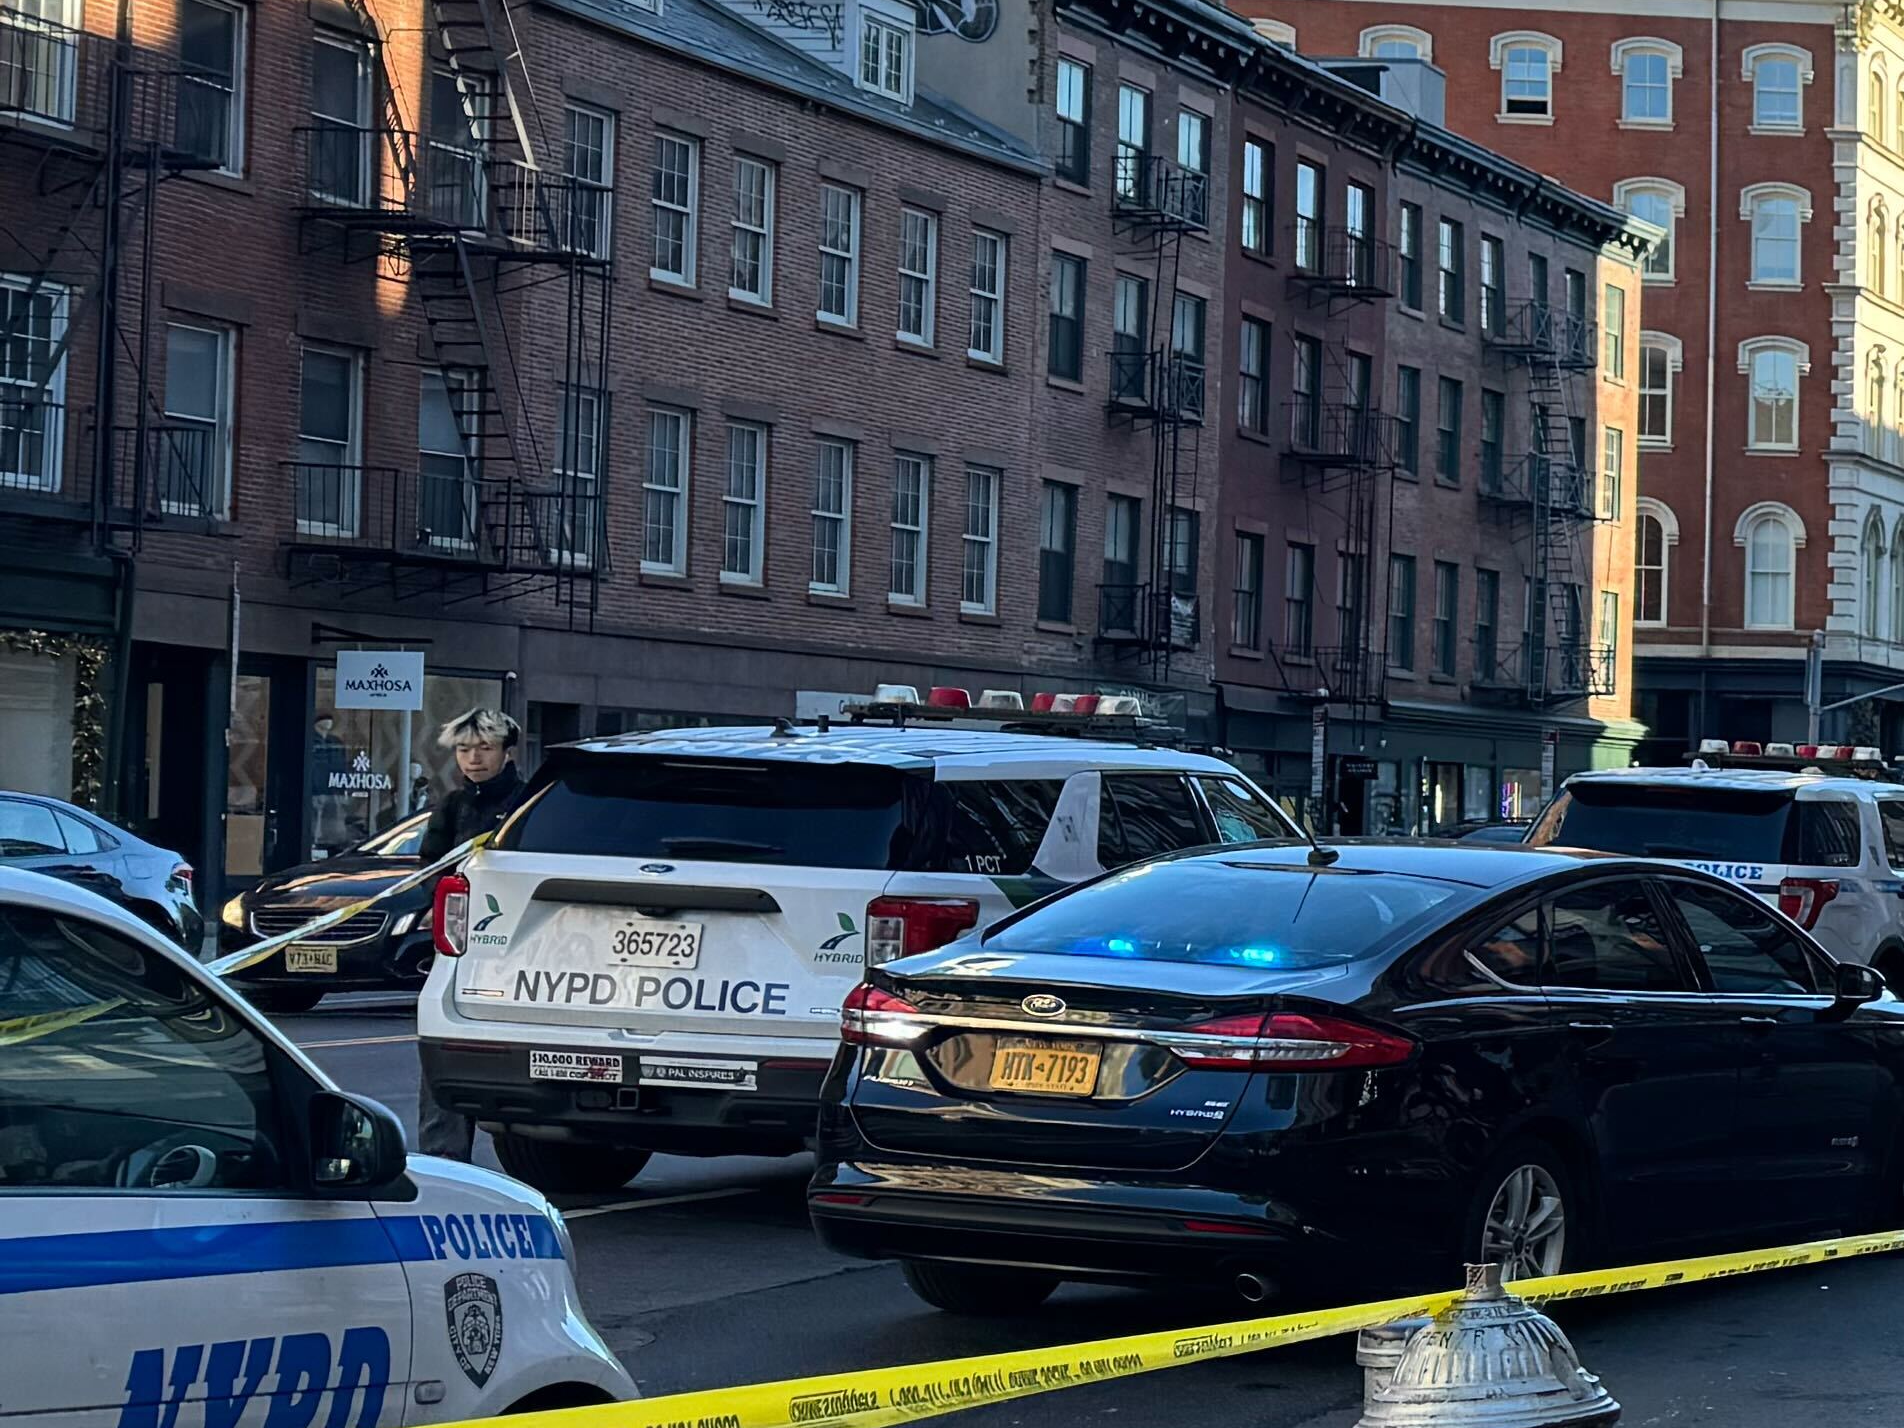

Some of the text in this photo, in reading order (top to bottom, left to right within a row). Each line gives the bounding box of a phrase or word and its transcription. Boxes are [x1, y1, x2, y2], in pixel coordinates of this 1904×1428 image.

[344, 679, 412, 692] MAXHOSA
[327, 772, 392, 790] MAXHOSA
[975, 855, 1001, 873] PCT
[470, 934, 508, 946] HYBRID
[612, 929, 696, 959] 365723
[813, 952, 864, 964] HYBRID
[512, 970, 791, 1015] NYPD POLICE
[575, 1055, 621, 1069] REWARD
[1047, 1055, 1090, 1085] 7193
[422, 1213, 534, 1260] POLICE
[455, 1274, 487, 1289] POLICE
